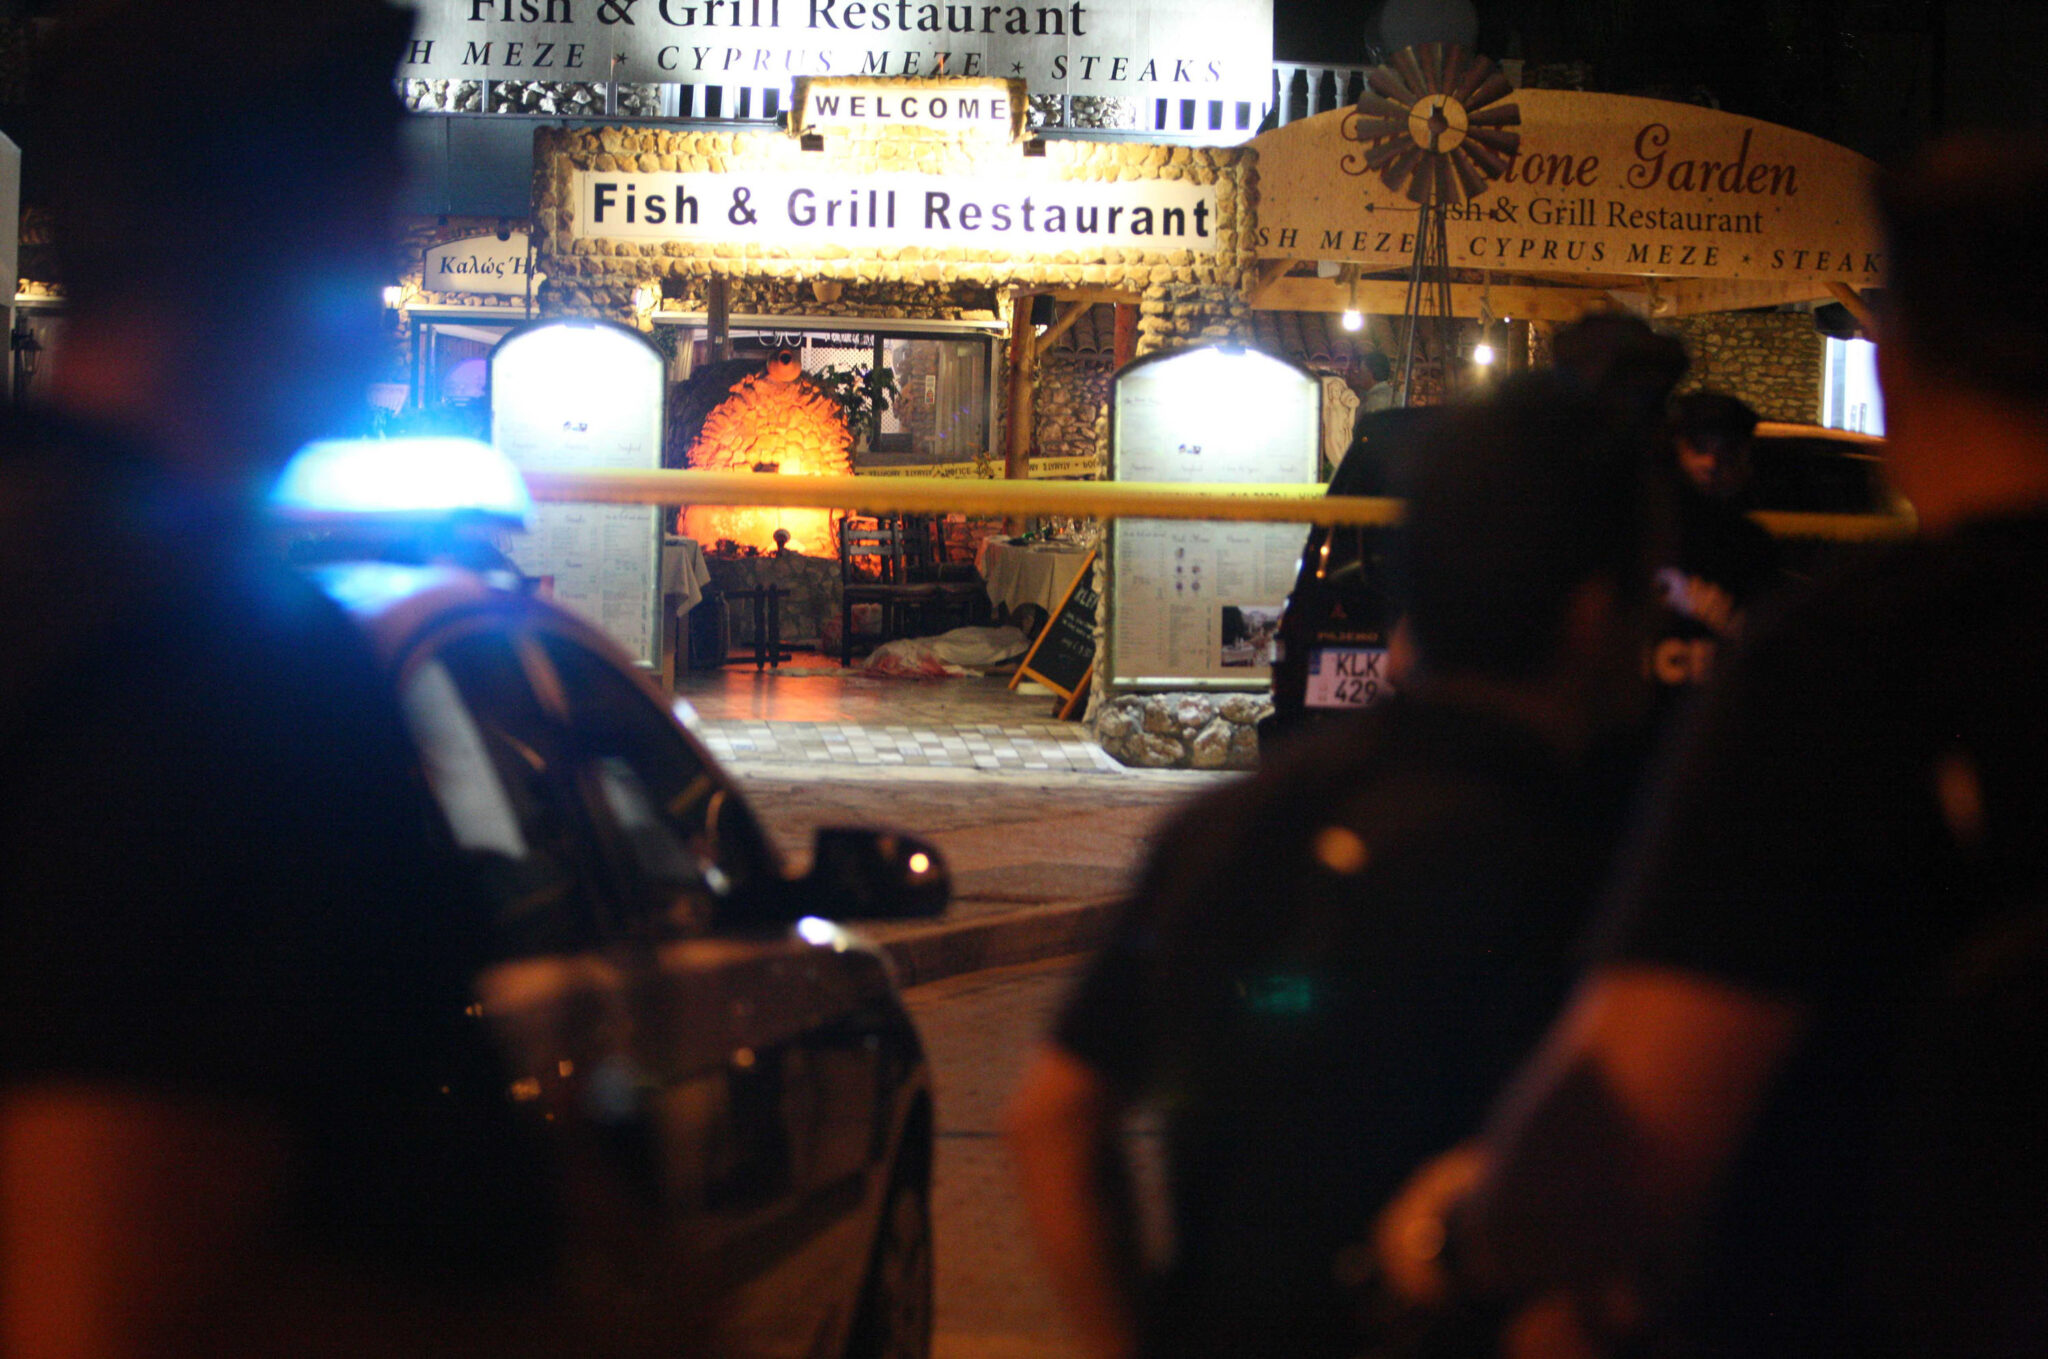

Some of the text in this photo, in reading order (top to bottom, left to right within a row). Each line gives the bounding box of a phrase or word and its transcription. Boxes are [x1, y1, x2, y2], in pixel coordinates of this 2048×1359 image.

[467, 0, 1087, 37] Fish & Grill Restaurant
[461, 41, 585, 68] MEZE
[657, 46, 833, 72] CYPRUS
[861, 50, 983, 76] MEZE
[1051, 55, 1224, 83] STEAKS
[815, 95, 1007, 121] WELCOME
[1627, 123, 1798, 197] Garden
[594, 183, 1210, 238] Fish & Grill Restaurant
[1443, 197, 1764, 234] ish & Grill Restaurant
[439, 255, 505, 279] Καλώς
[1258, 227, 1881, 273] SH MEZE CYPRUS MEZE STEAK
[1336, 652, 1380, 677] KLK
[1334, 679, 1378, 704] 429
